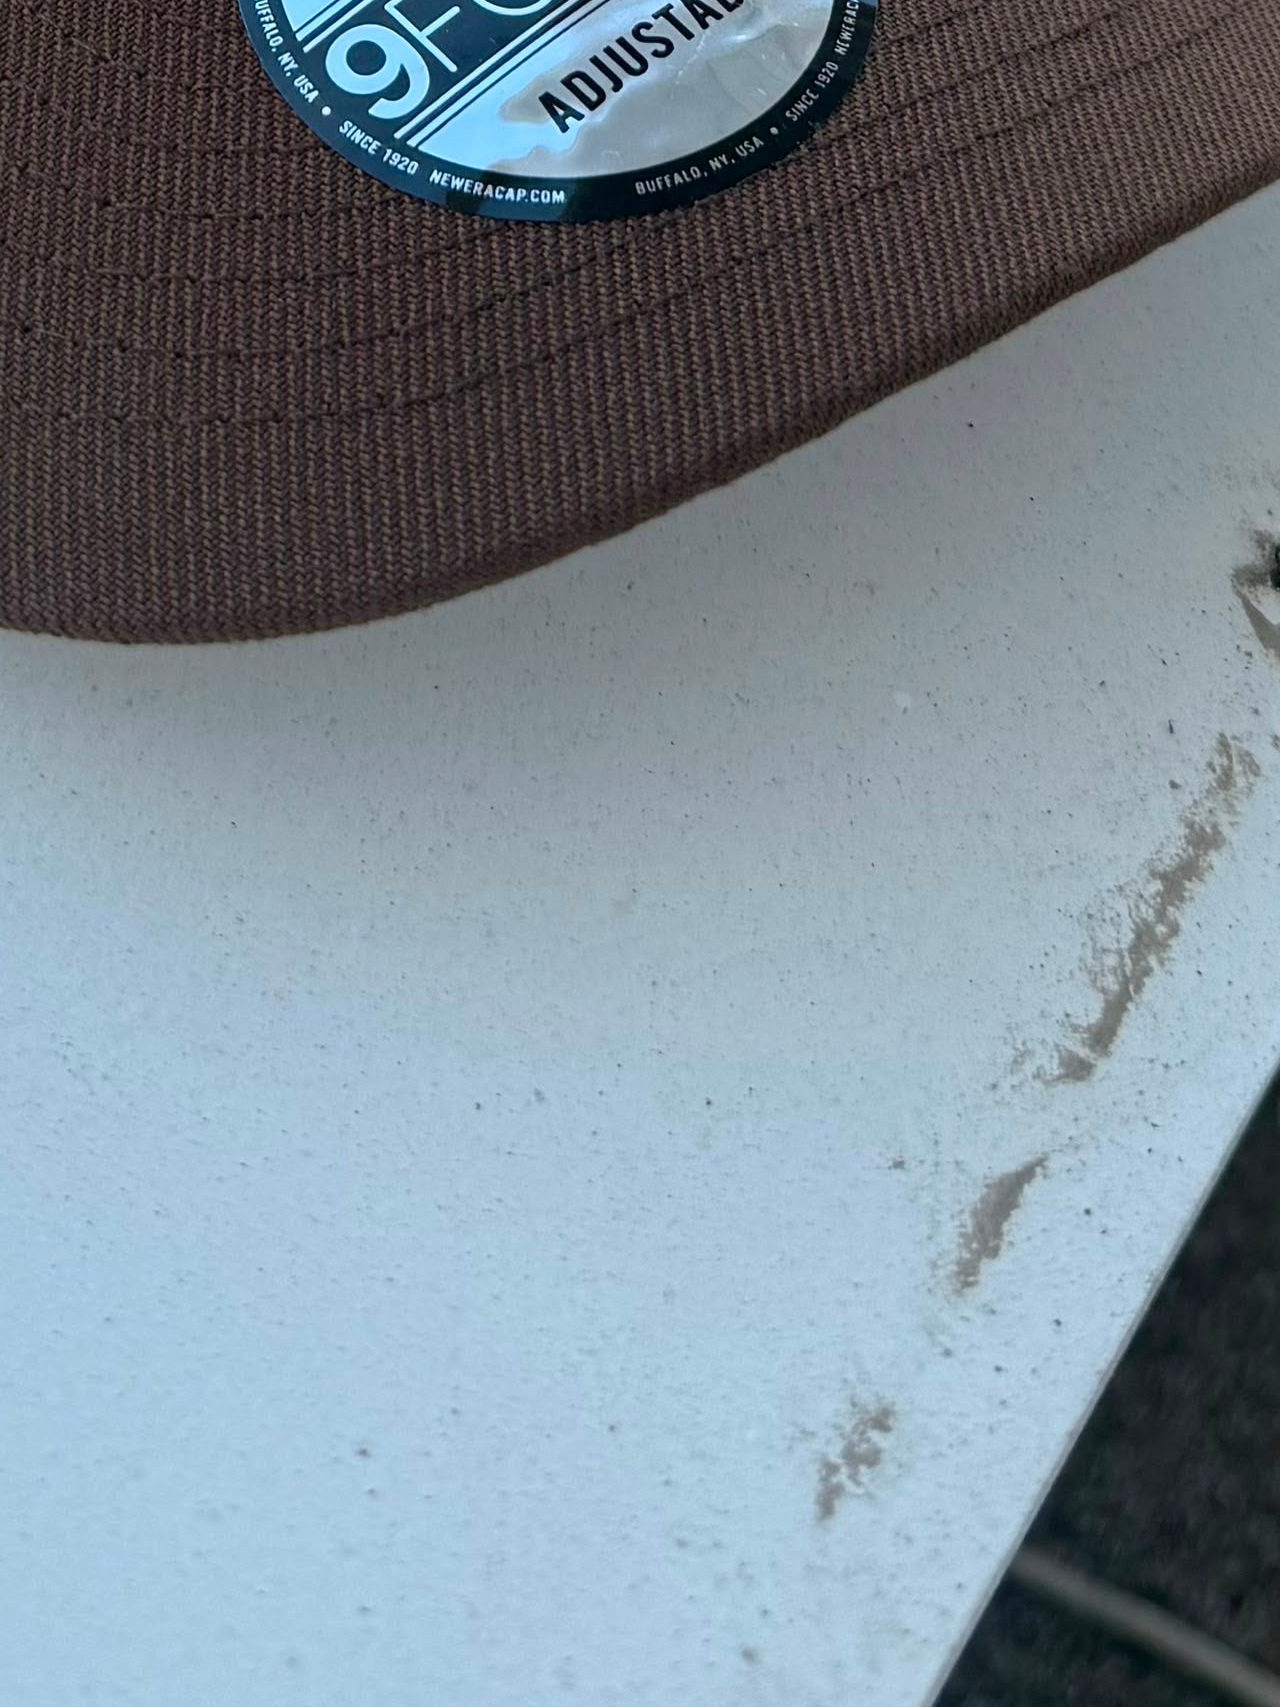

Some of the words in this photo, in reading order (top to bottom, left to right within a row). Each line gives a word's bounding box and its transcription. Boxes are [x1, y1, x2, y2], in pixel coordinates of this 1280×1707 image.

[294, 74, 320, 103] USA
[339, 120, 381, 155] SINCE
[383, 148, 419, 175] 1920
[429, 169, 566, 204] NEWERACAP.COM
[735, 136, 765, 158] USA
[785, 89, 820, 122] SINCE
[814, 61, 839, 92] 1920
